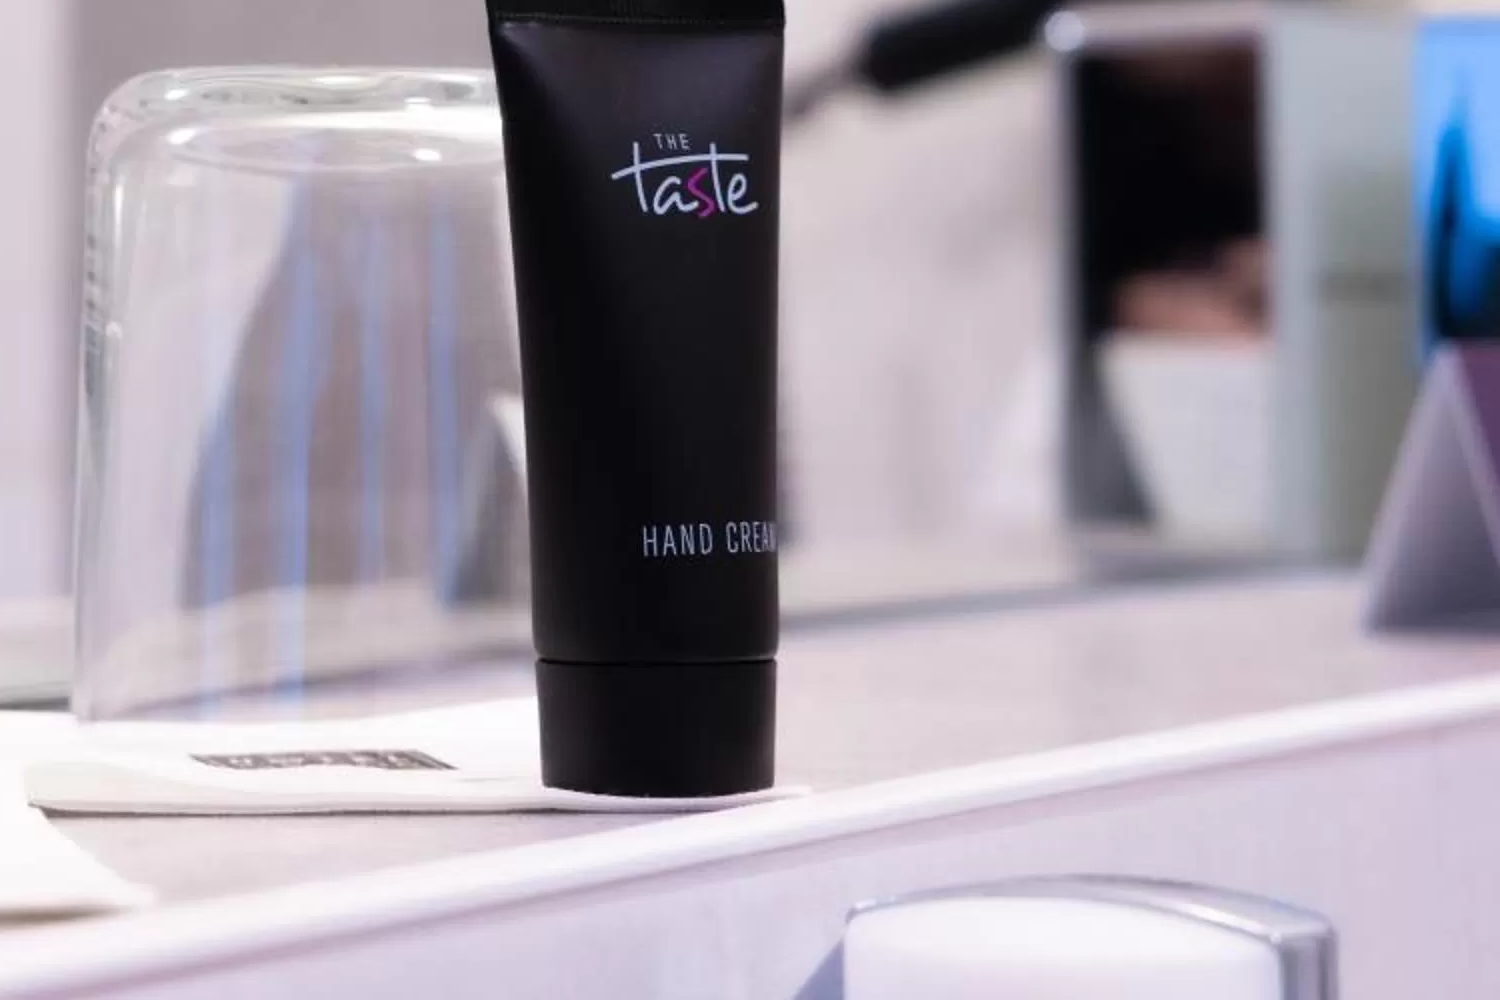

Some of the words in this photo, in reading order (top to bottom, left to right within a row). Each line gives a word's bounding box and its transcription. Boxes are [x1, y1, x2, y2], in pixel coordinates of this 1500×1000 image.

[653, 132, 691, 150] THE
[611, 140, 759, 218] taste
[642, 523, 713, 557] HAND
